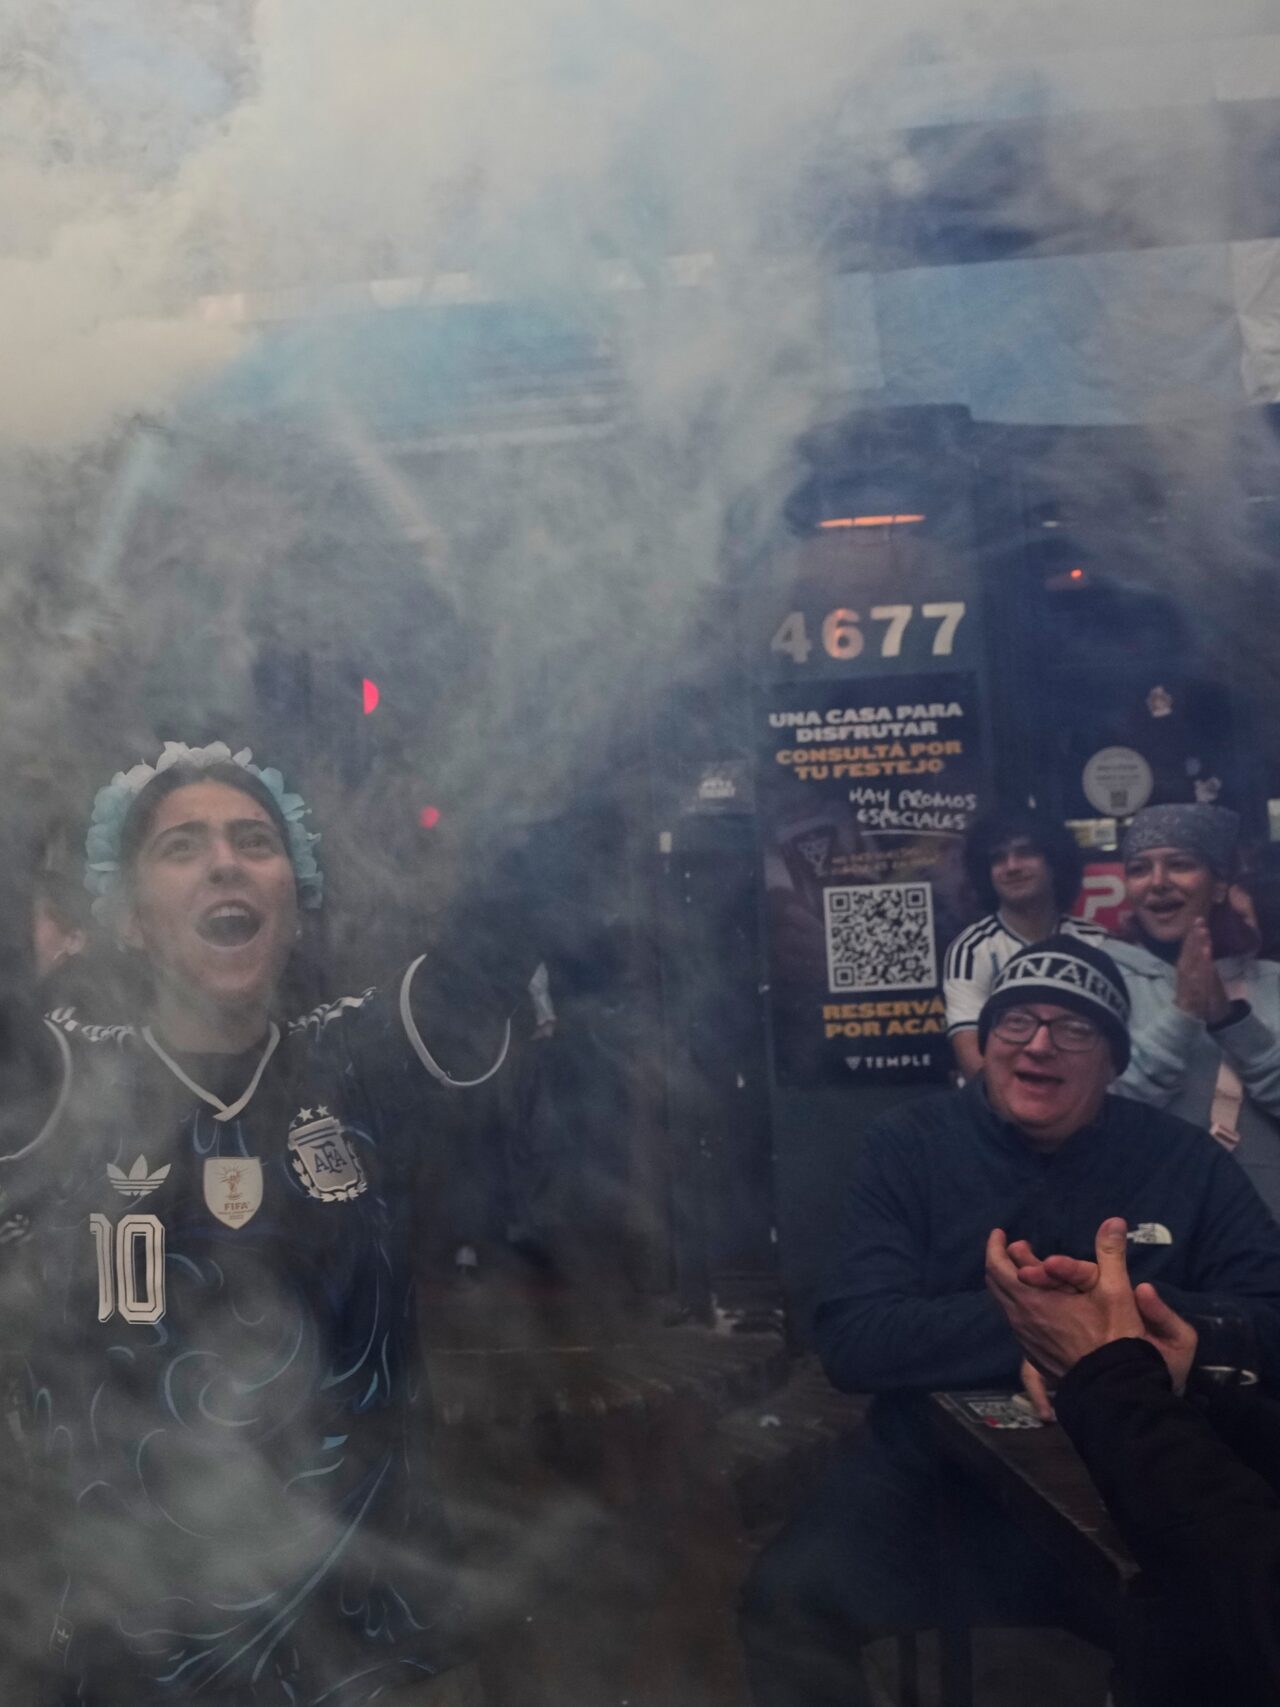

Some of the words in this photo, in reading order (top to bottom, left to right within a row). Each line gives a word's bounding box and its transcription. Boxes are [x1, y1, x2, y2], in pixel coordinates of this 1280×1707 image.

[771, 602, 966, 664] 4677
[769, 711, 822, 728] UNA
[826, 707, 892, 724] CASA
[896, 702, 964, 720] PARA
[796, 720, 937, 742] DISFRUTAR
[909, 740, 963, 757] POR
[794, 765, 828, 781] TU
[833, 759, 944, 778] FESTEJO
[849, 787, 890, 809] HAY
[898, 789, 977, 811] PROMOS
[824, 1021, 881, 1038] POR
[865, 1054, 931, 1068] TEMPLE
[224, 1202, 249, 1211] FIFA
[89, 1212, 167, 1325] 10
